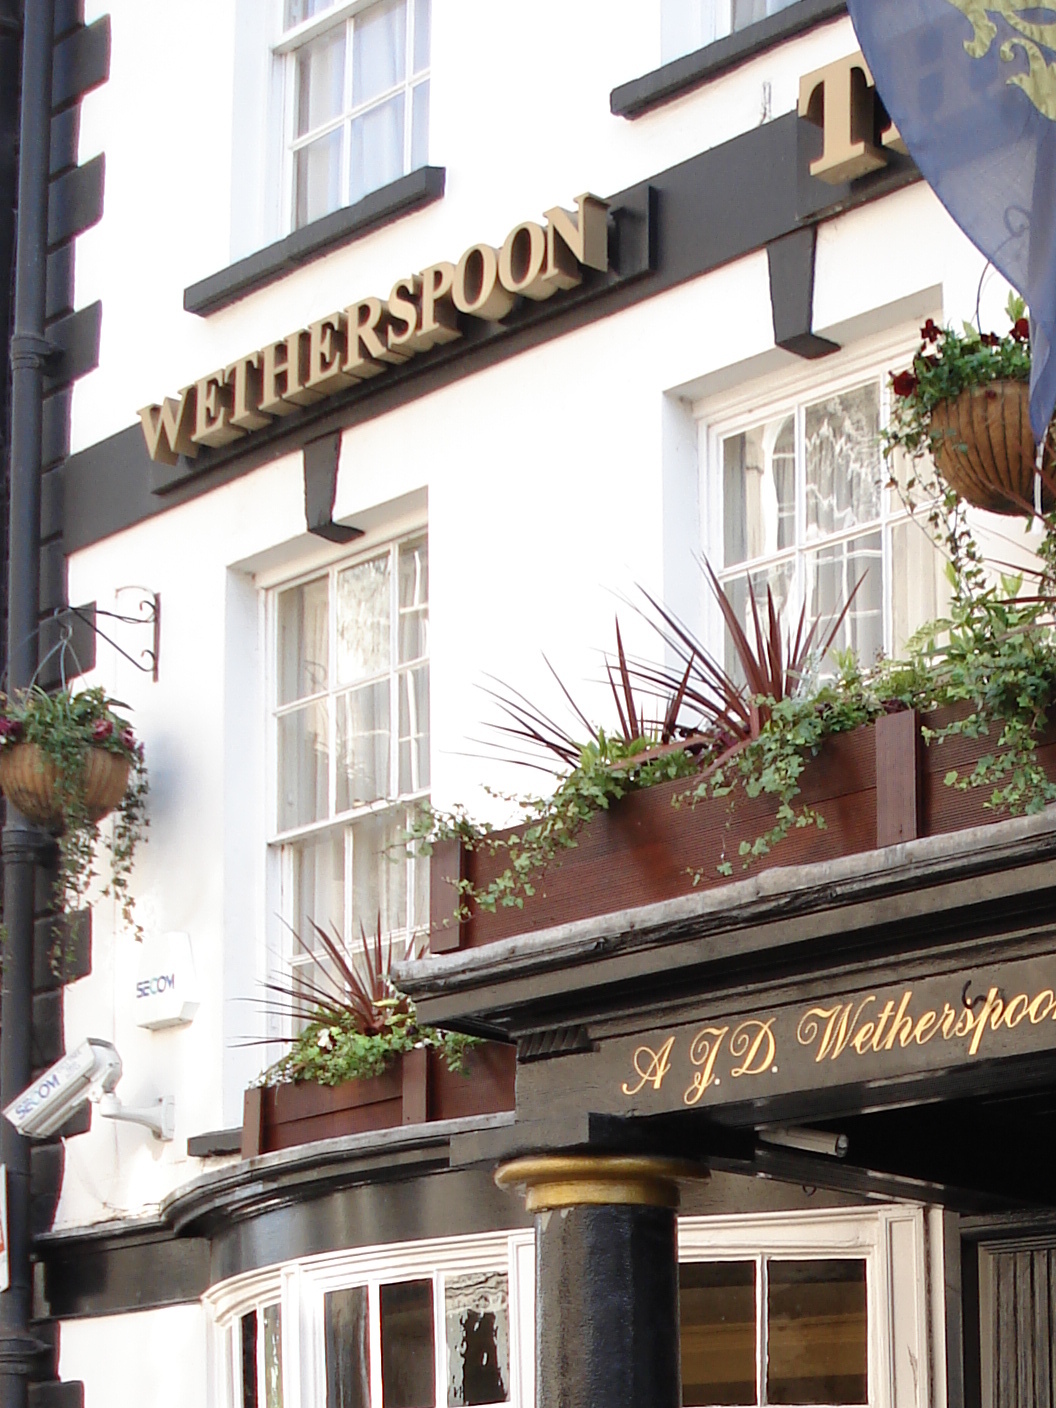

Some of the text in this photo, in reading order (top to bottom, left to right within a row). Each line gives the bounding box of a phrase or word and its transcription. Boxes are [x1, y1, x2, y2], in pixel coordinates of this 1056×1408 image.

[136, 191, 612, 465] WETHERSPOON
[136, 973, 175, 998] SECOM
[621, 1036, 676, 1096] A
[15, 1073, 61, 1121] SECOM
